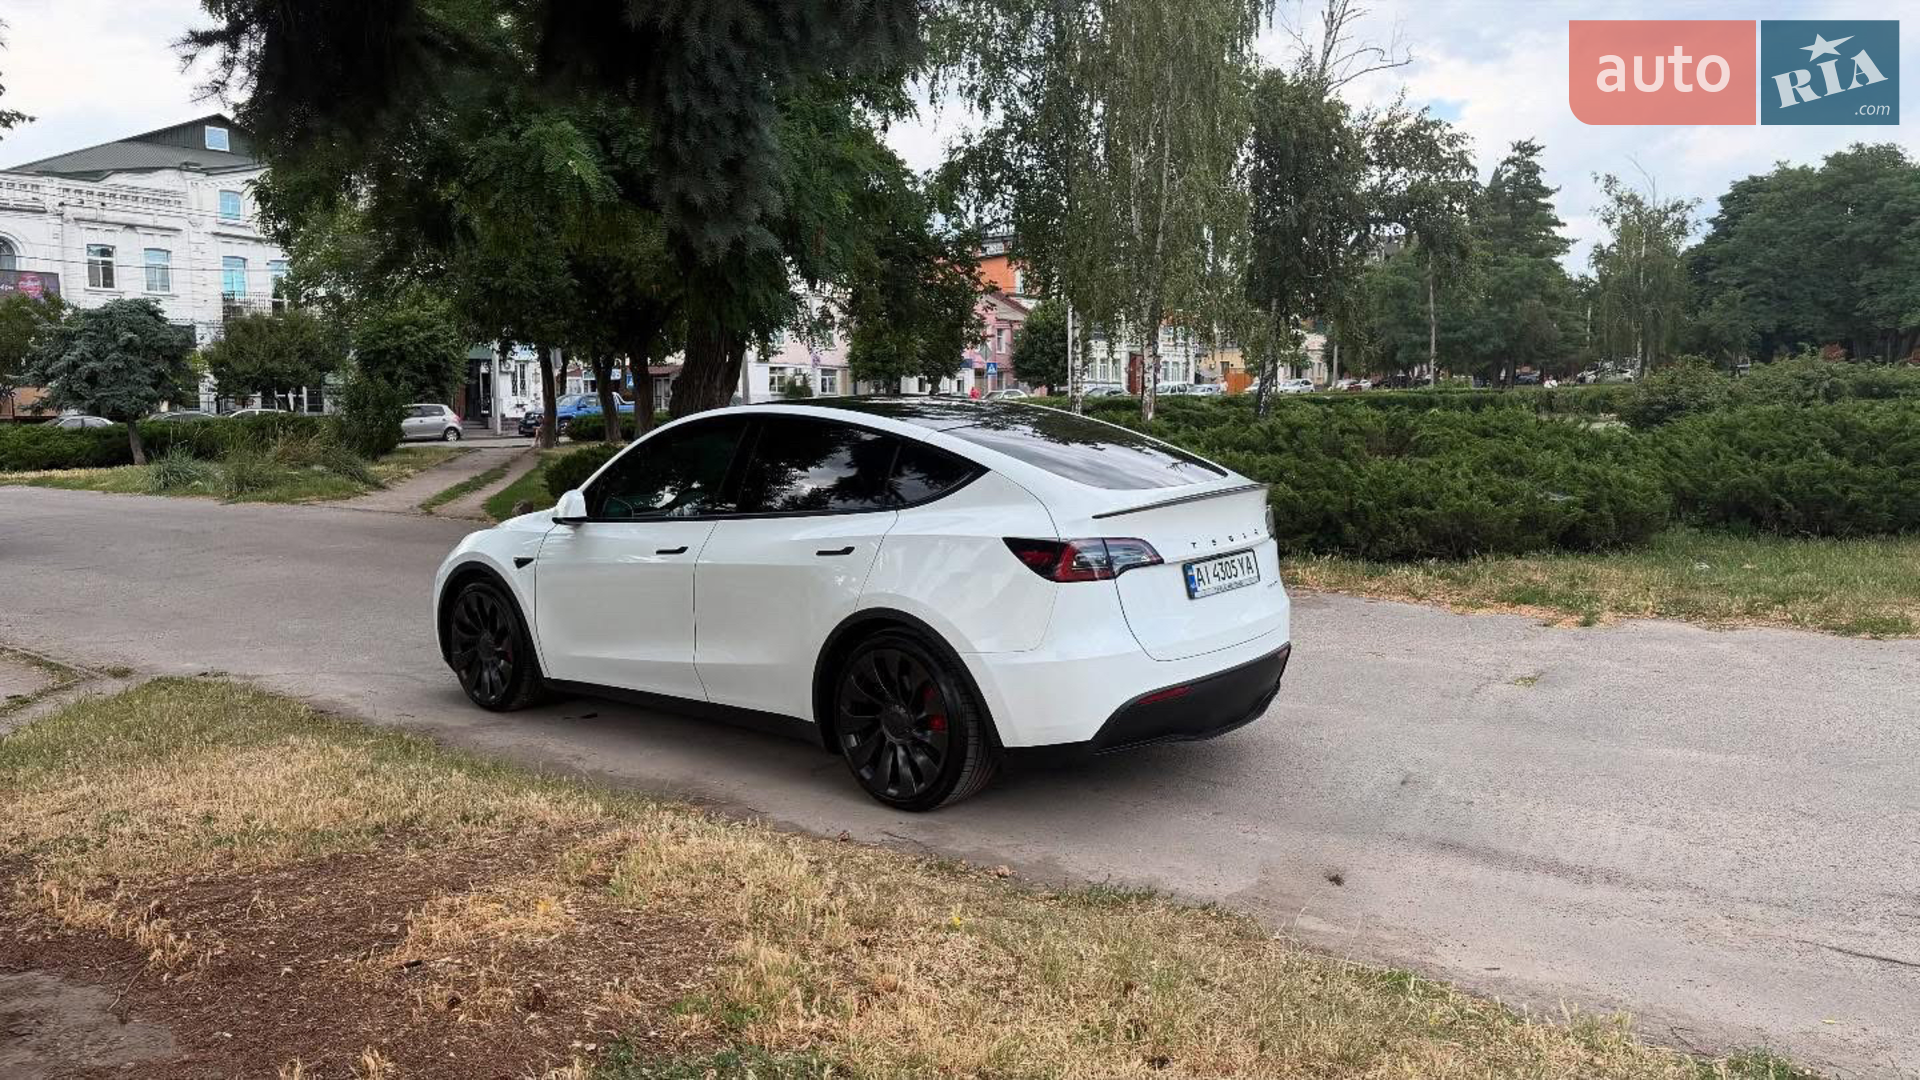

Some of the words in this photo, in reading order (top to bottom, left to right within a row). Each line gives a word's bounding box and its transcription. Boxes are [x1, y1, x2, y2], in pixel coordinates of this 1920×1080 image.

[1196, 565, 1211, 588] AI
[1212, 559, 1238, 582] 4305
[1238, 555, 1254, 577] YA
